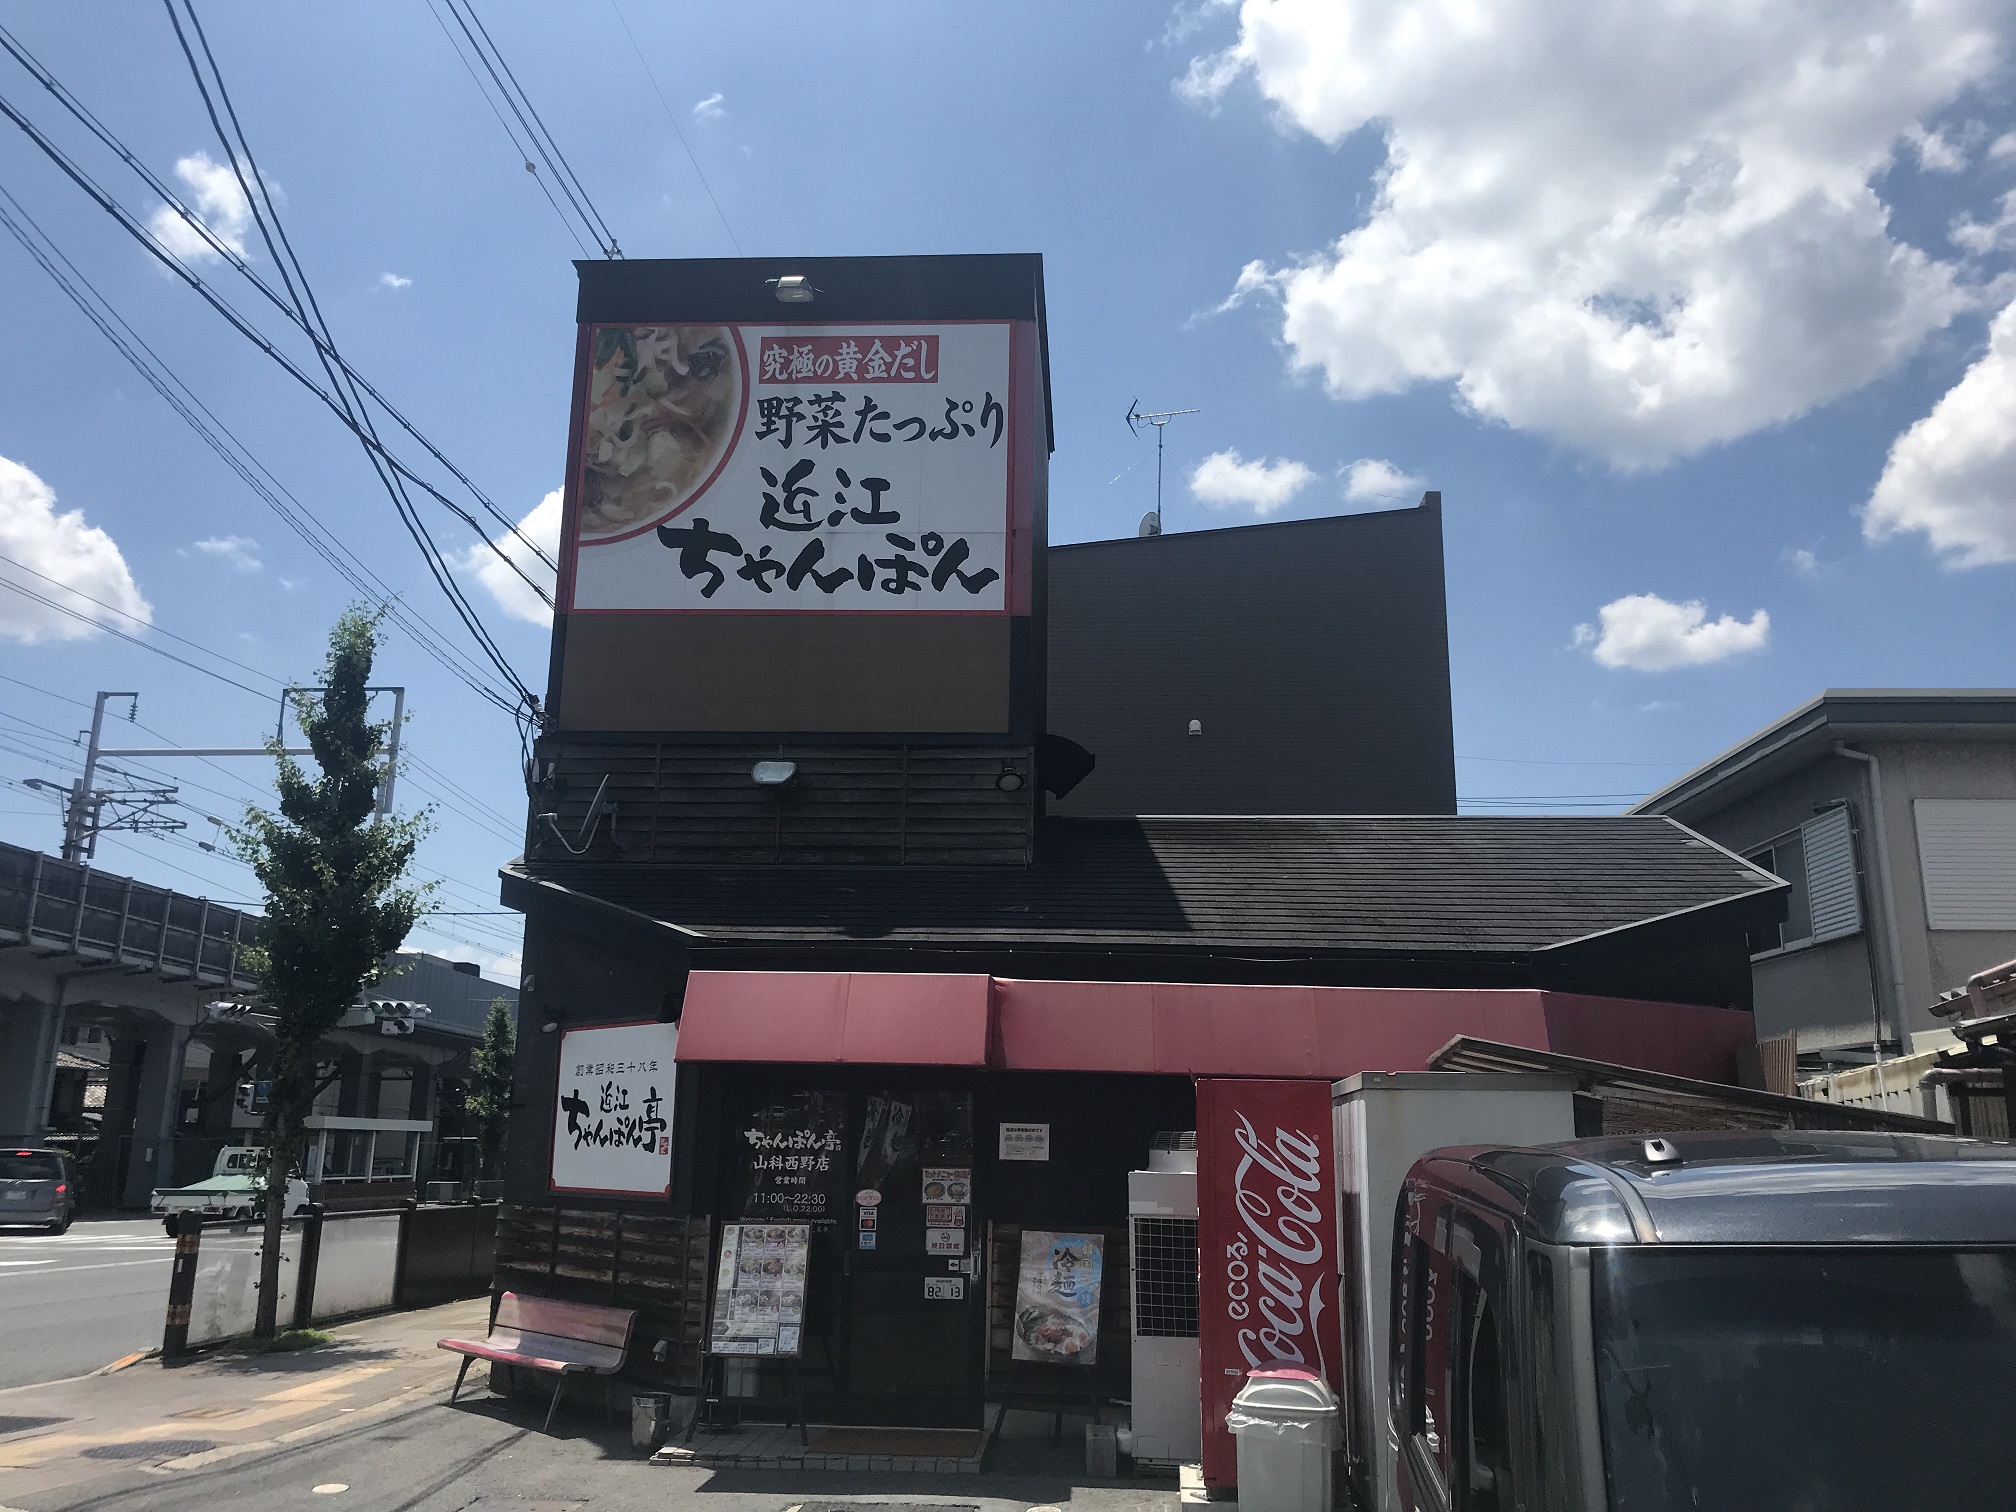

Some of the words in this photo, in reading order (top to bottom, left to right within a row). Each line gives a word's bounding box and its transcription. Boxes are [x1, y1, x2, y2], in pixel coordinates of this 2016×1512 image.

[762, 339, 937, 381] 究極の黄金だし
[754, 391, 1005, 450] 野菜たっぷり
[759, 458, 901, 532] 近江
[656, 517, 1000, 599] ちゃんぽん
[575, 1060, 659, 1077] 創業昭和三十八年
[600, 1080, 630, 1114] 近江
[561, 1086, 667, 1154] ちゃんぽん亭
[743, 1128, 841, 1151] ちゃんぽん亭
[752, 1154, 830, 1172] 山科西野店
[774, 1175, 807, 1186] 営業時間
